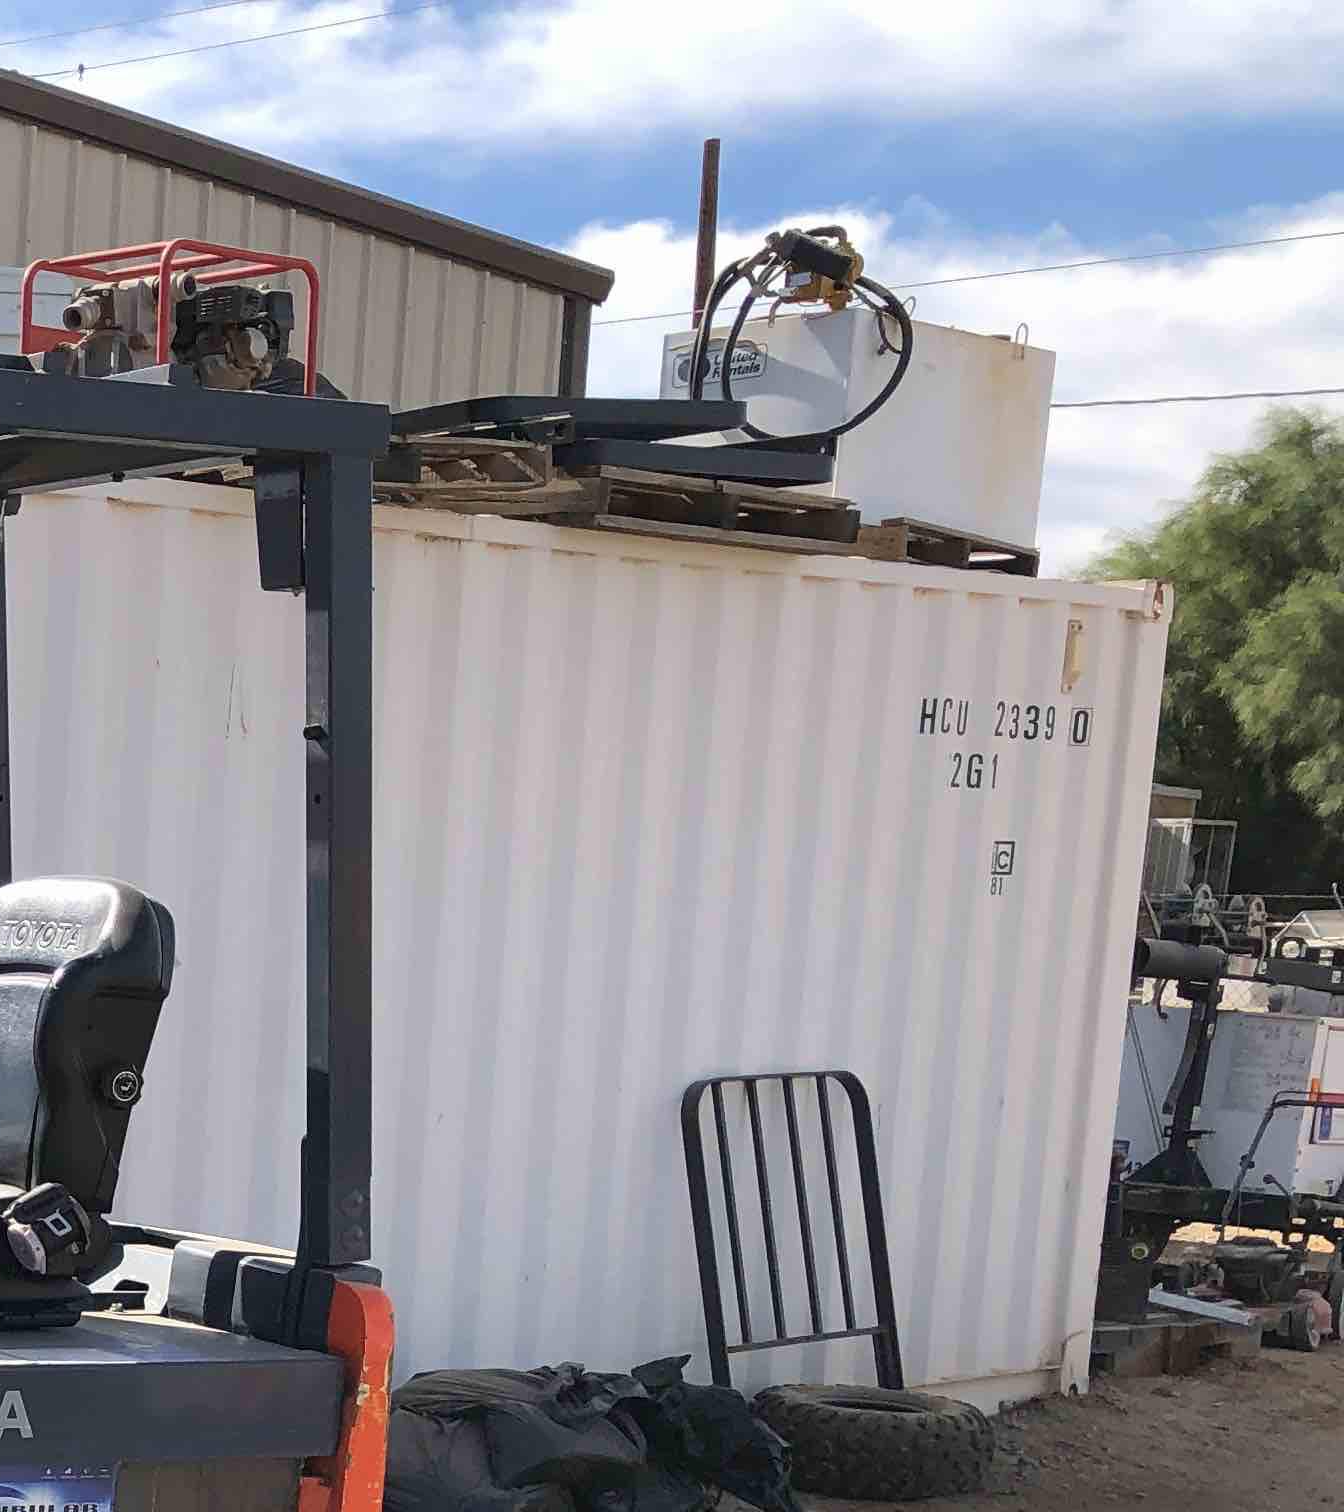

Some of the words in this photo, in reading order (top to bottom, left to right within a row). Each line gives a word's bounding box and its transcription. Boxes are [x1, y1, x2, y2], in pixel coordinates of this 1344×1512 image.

[919, 698, 969, 735] HCU
[1072, 710, 1089, 743] 0
[1, 919, 82, 950] TOYOTA
